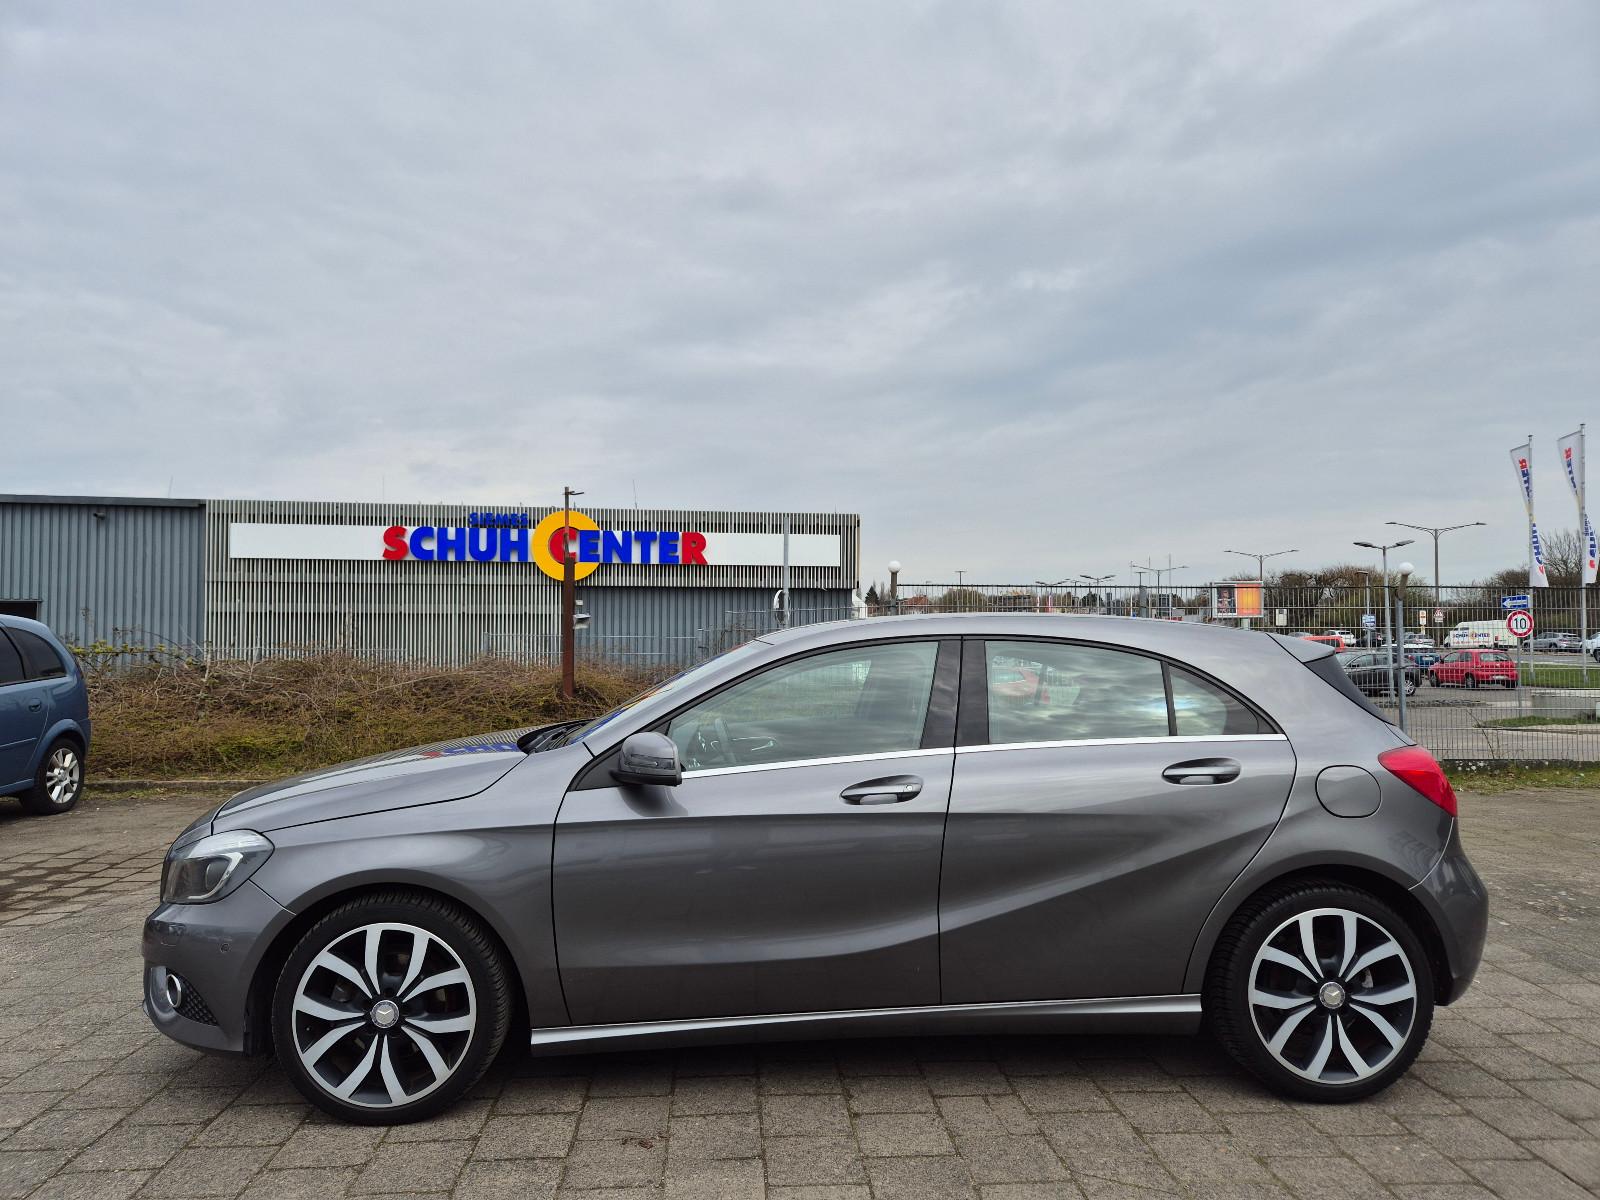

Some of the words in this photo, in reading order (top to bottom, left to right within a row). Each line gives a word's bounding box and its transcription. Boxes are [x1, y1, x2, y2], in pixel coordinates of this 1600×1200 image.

[468, 512, 528, 526] SIEMES
[382, 525, 529, 563] SCHUH
[548, 526, 708, 566] CENTER
[1514, 617, 1527, 630] 10
